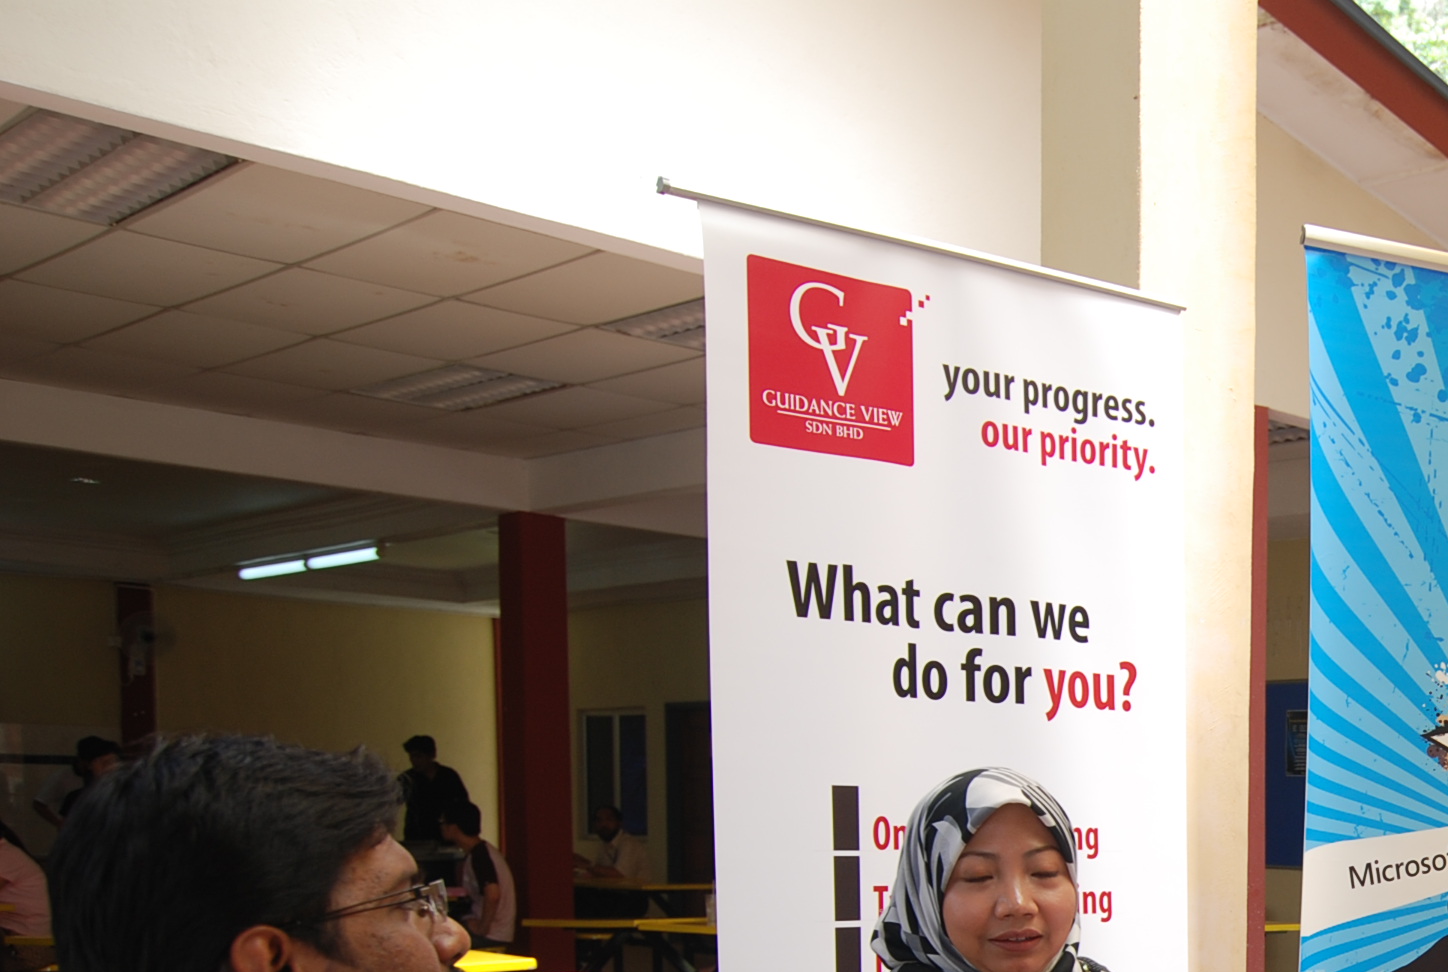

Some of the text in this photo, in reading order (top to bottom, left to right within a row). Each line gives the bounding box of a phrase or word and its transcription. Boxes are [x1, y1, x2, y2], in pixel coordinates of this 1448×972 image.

[788, 281, 869, 397] GV
[761, 389, 904, 427] GUIDANCE VIEW
[942, 363, 1156, 428] your progress.
[805, 420, 864, 440] SDN BHD
[981, 420, 1156, 482] our priority.
[786, 559, 1091, 643] What can we
[892, 643, 1138, 722] do for you?
